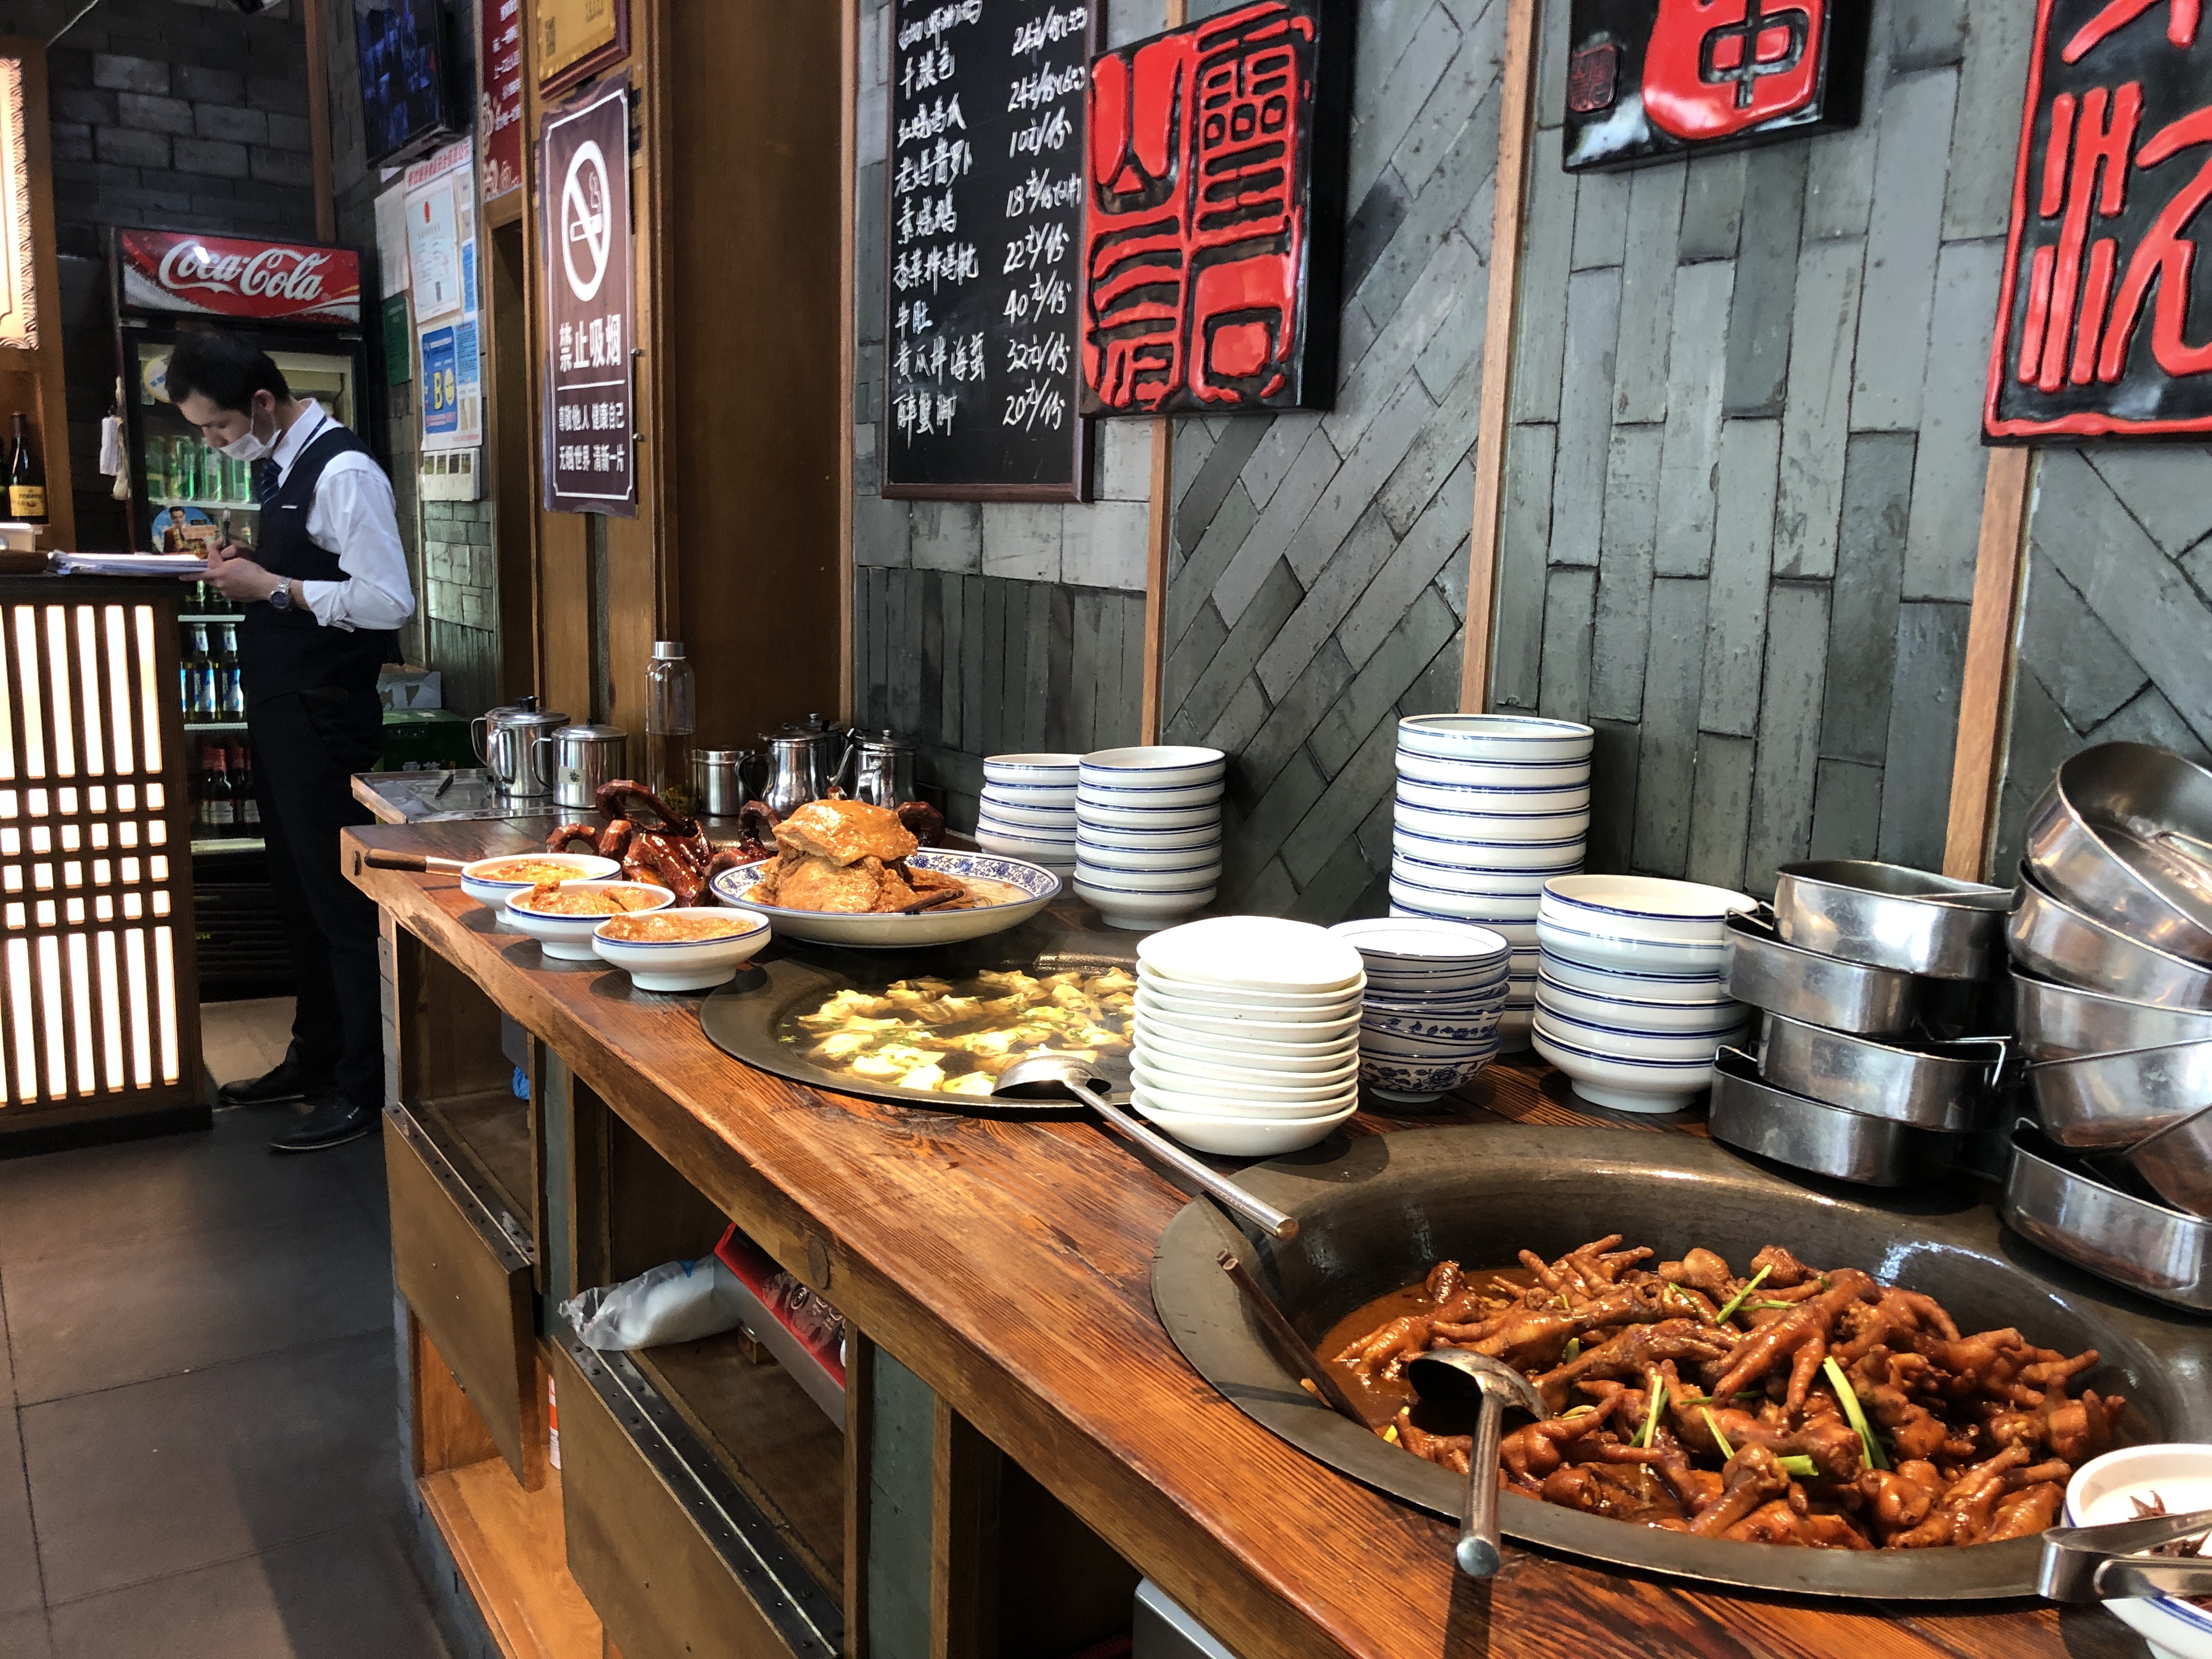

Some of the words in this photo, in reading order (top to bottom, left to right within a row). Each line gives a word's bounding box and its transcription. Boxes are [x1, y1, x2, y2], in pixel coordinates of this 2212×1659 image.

[159, 240, 330, 301] Coca-Cola
[1003, 222, 1070, 274] 22元/份
[1002, 270, 1071, 325] 40元/份
[558, 314, 622, 373] 禁止吸烟
[592, 401, 625, 430] 健康自己
[1002, 377, 1066, 433] 20元/份
[559, 445, 590, 471] 无烟世界
[593, 443, 625, 472] 清新一片
